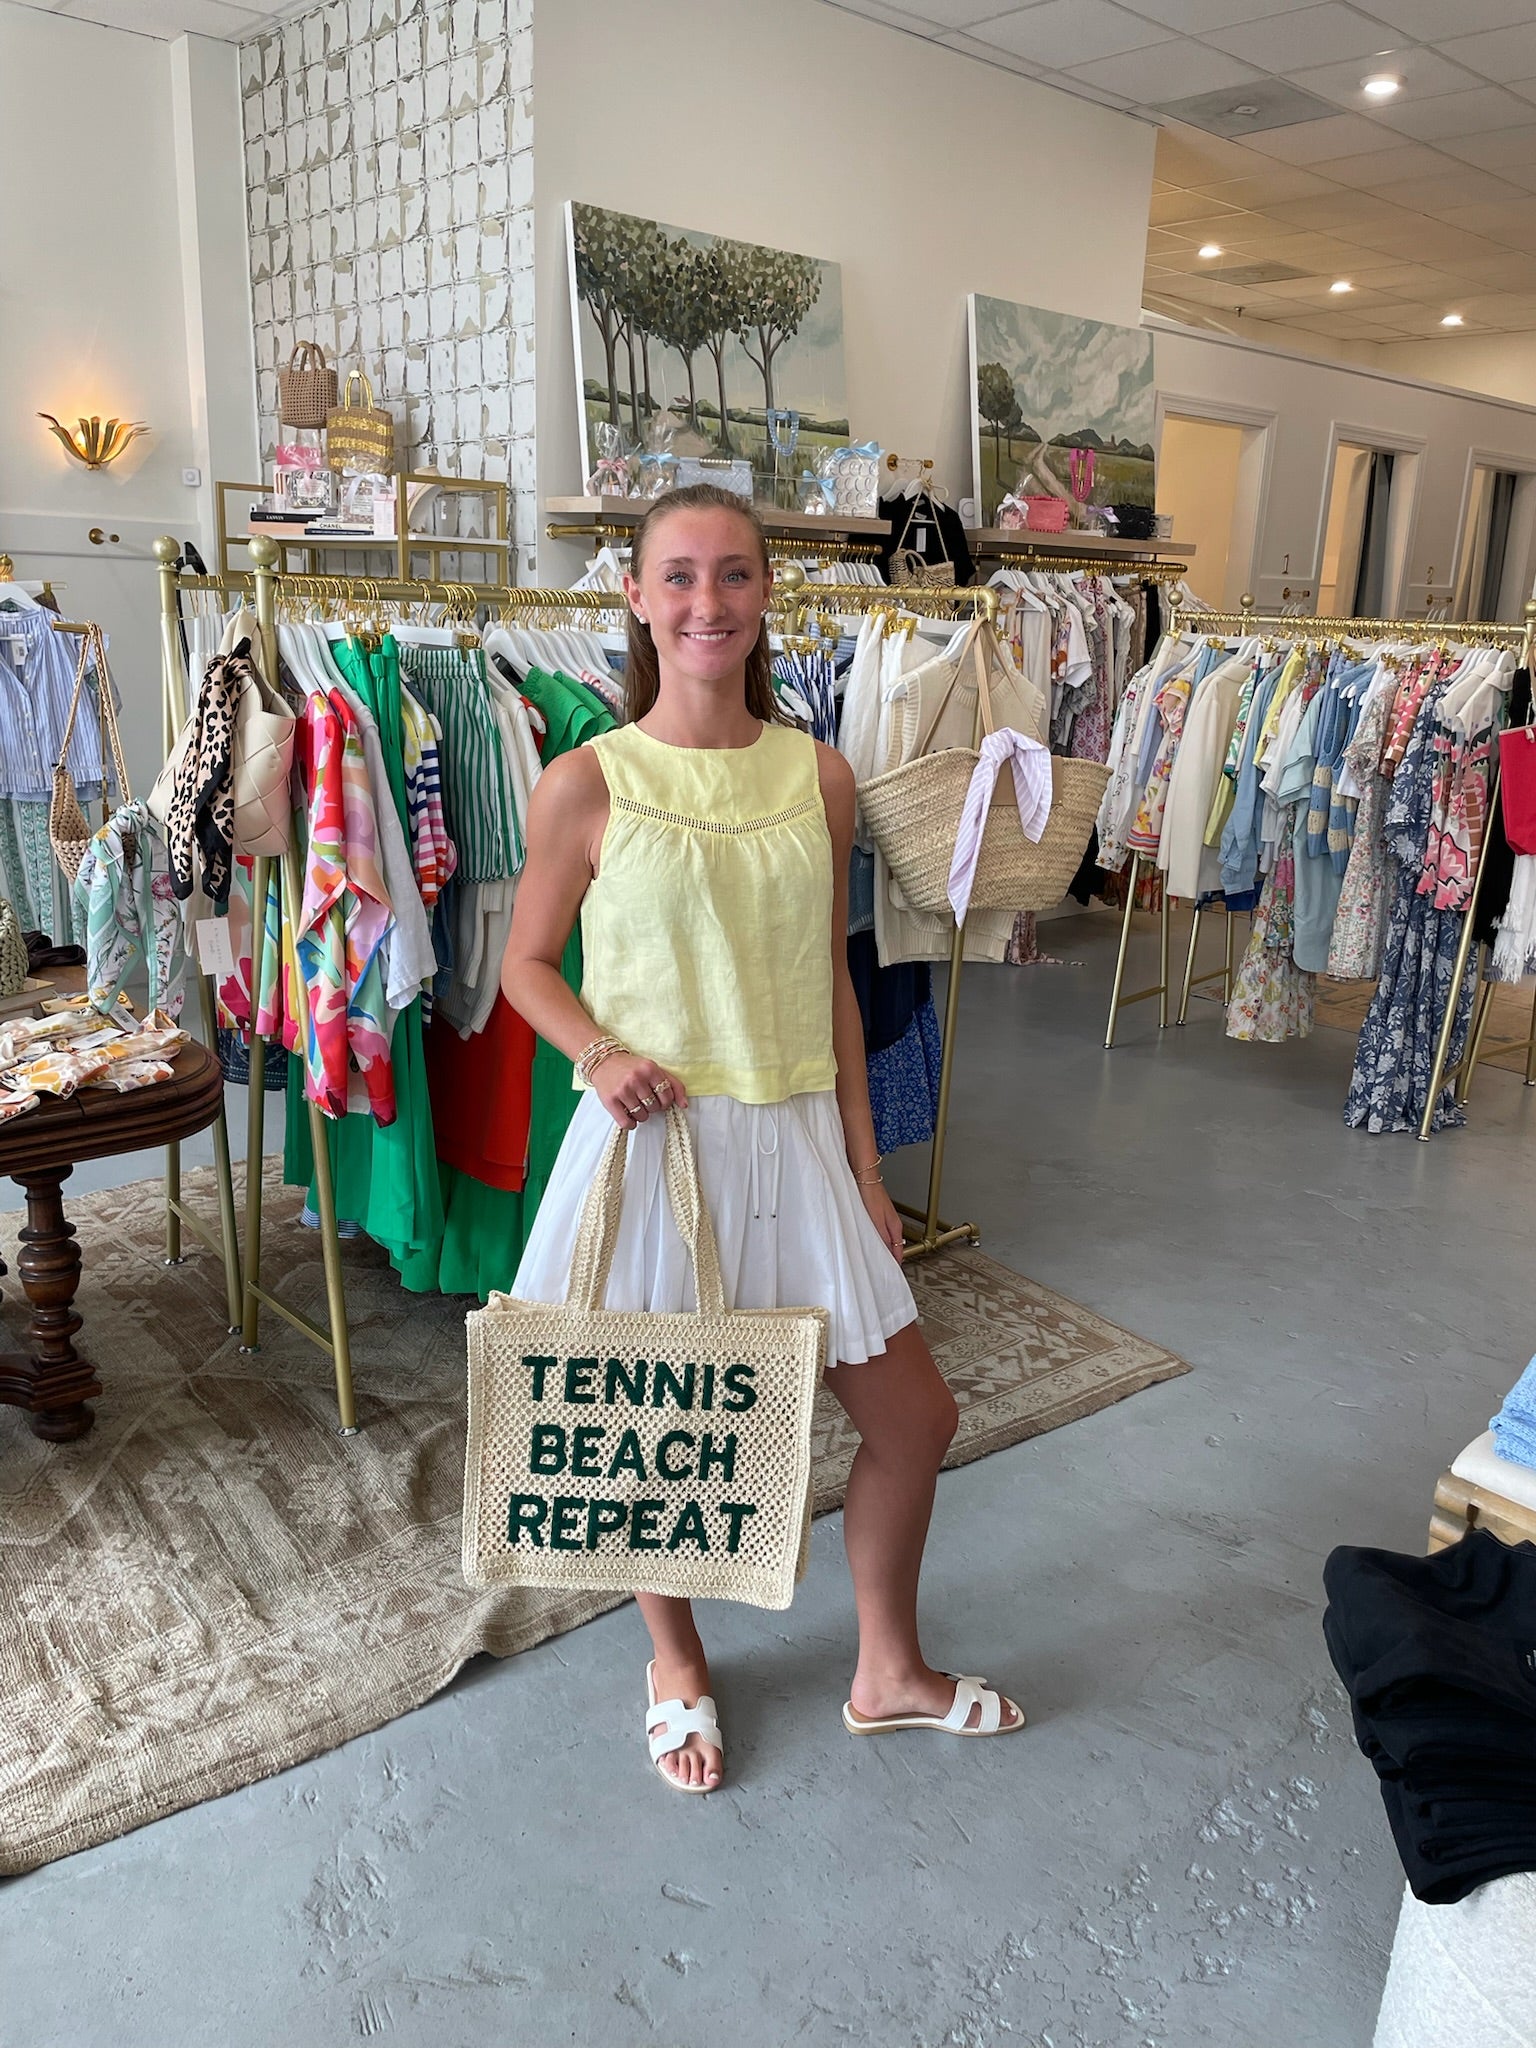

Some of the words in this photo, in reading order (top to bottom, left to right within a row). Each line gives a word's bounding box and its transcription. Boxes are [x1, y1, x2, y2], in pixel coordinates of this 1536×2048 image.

[1282, 553, 1289, 575] 1
[522, 1356, 758, 1412] TENNIS
[529, 1424, 737, 1482] BEACH
[507, 1494, 757, 1553] REPEAT
